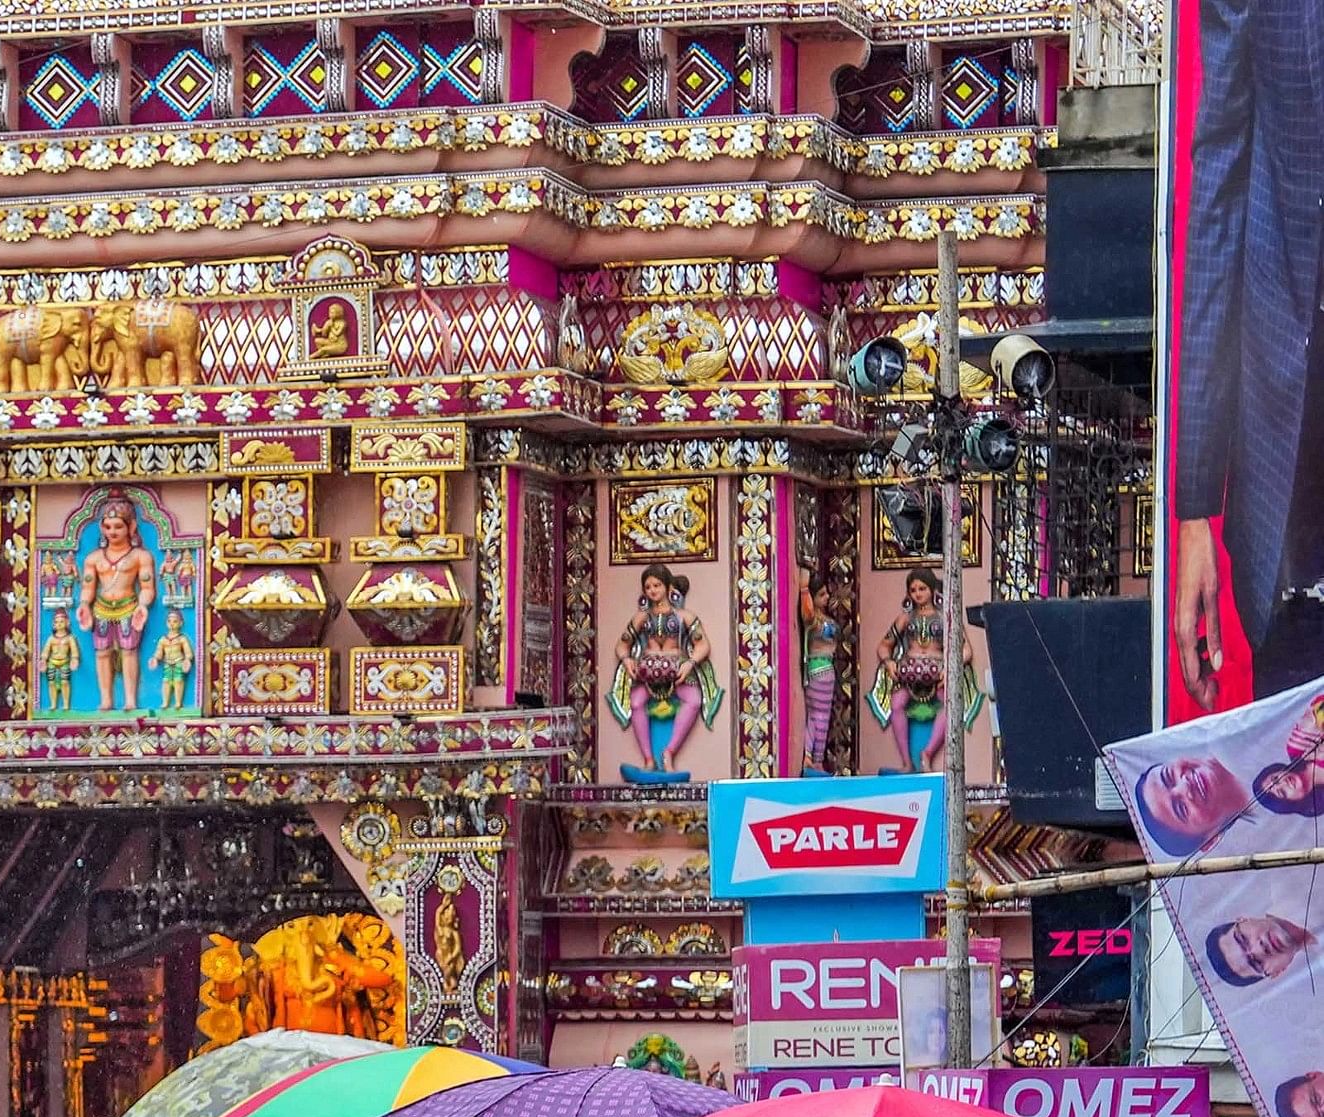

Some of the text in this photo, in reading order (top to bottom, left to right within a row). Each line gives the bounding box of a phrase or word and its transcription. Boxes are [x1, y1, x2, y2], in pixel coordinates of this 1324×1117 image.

[765, 822, 901, 853] PARLE
[770, 957, 899, 1010] REN
[774, 1038, 855, 1058] RENE
